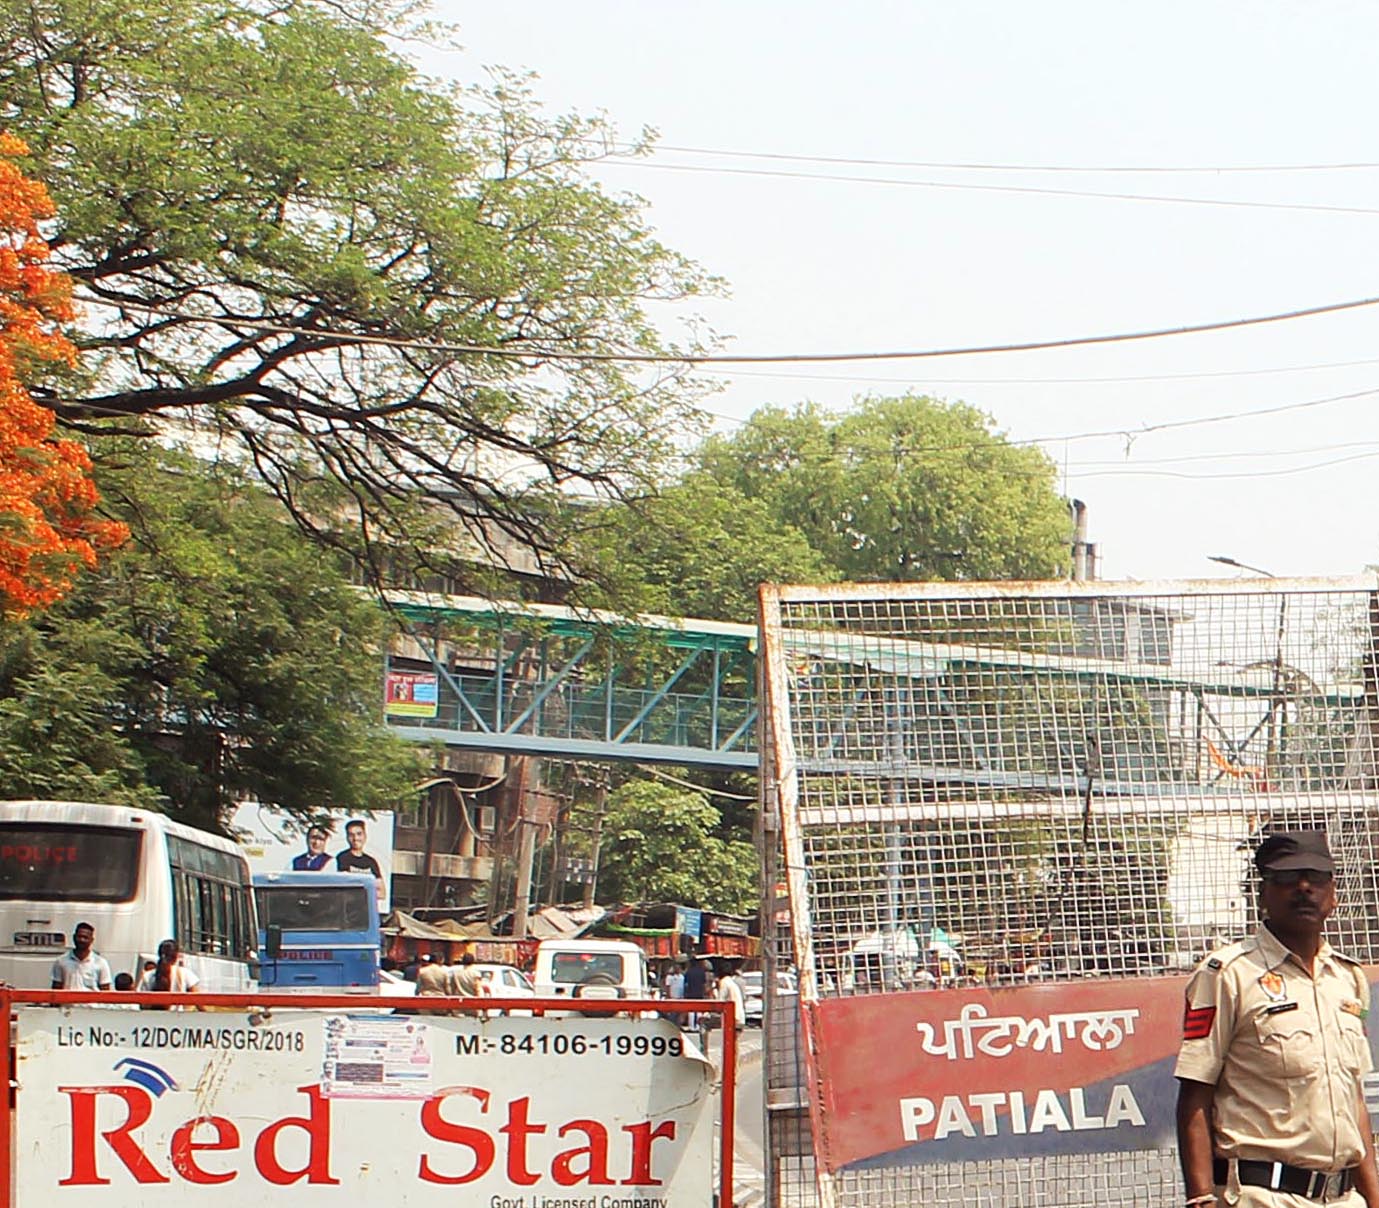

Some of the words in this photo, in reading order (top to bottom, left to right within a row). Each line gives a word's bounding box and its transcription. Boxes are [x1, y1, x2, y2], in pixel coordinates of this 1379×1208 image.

[57, 1026, 83, 1047] Lic
[132, 1027, 304, 1052] 12/DC/MA/SGR/2018
[917, 1004, 1139, 1061] ਪਟਿਆਲਾ
[58, 1084, 341, 1188] Red
[418, 1086, 677, 1188] Star
[898, 1084, 1146, 1142] PATIALA
